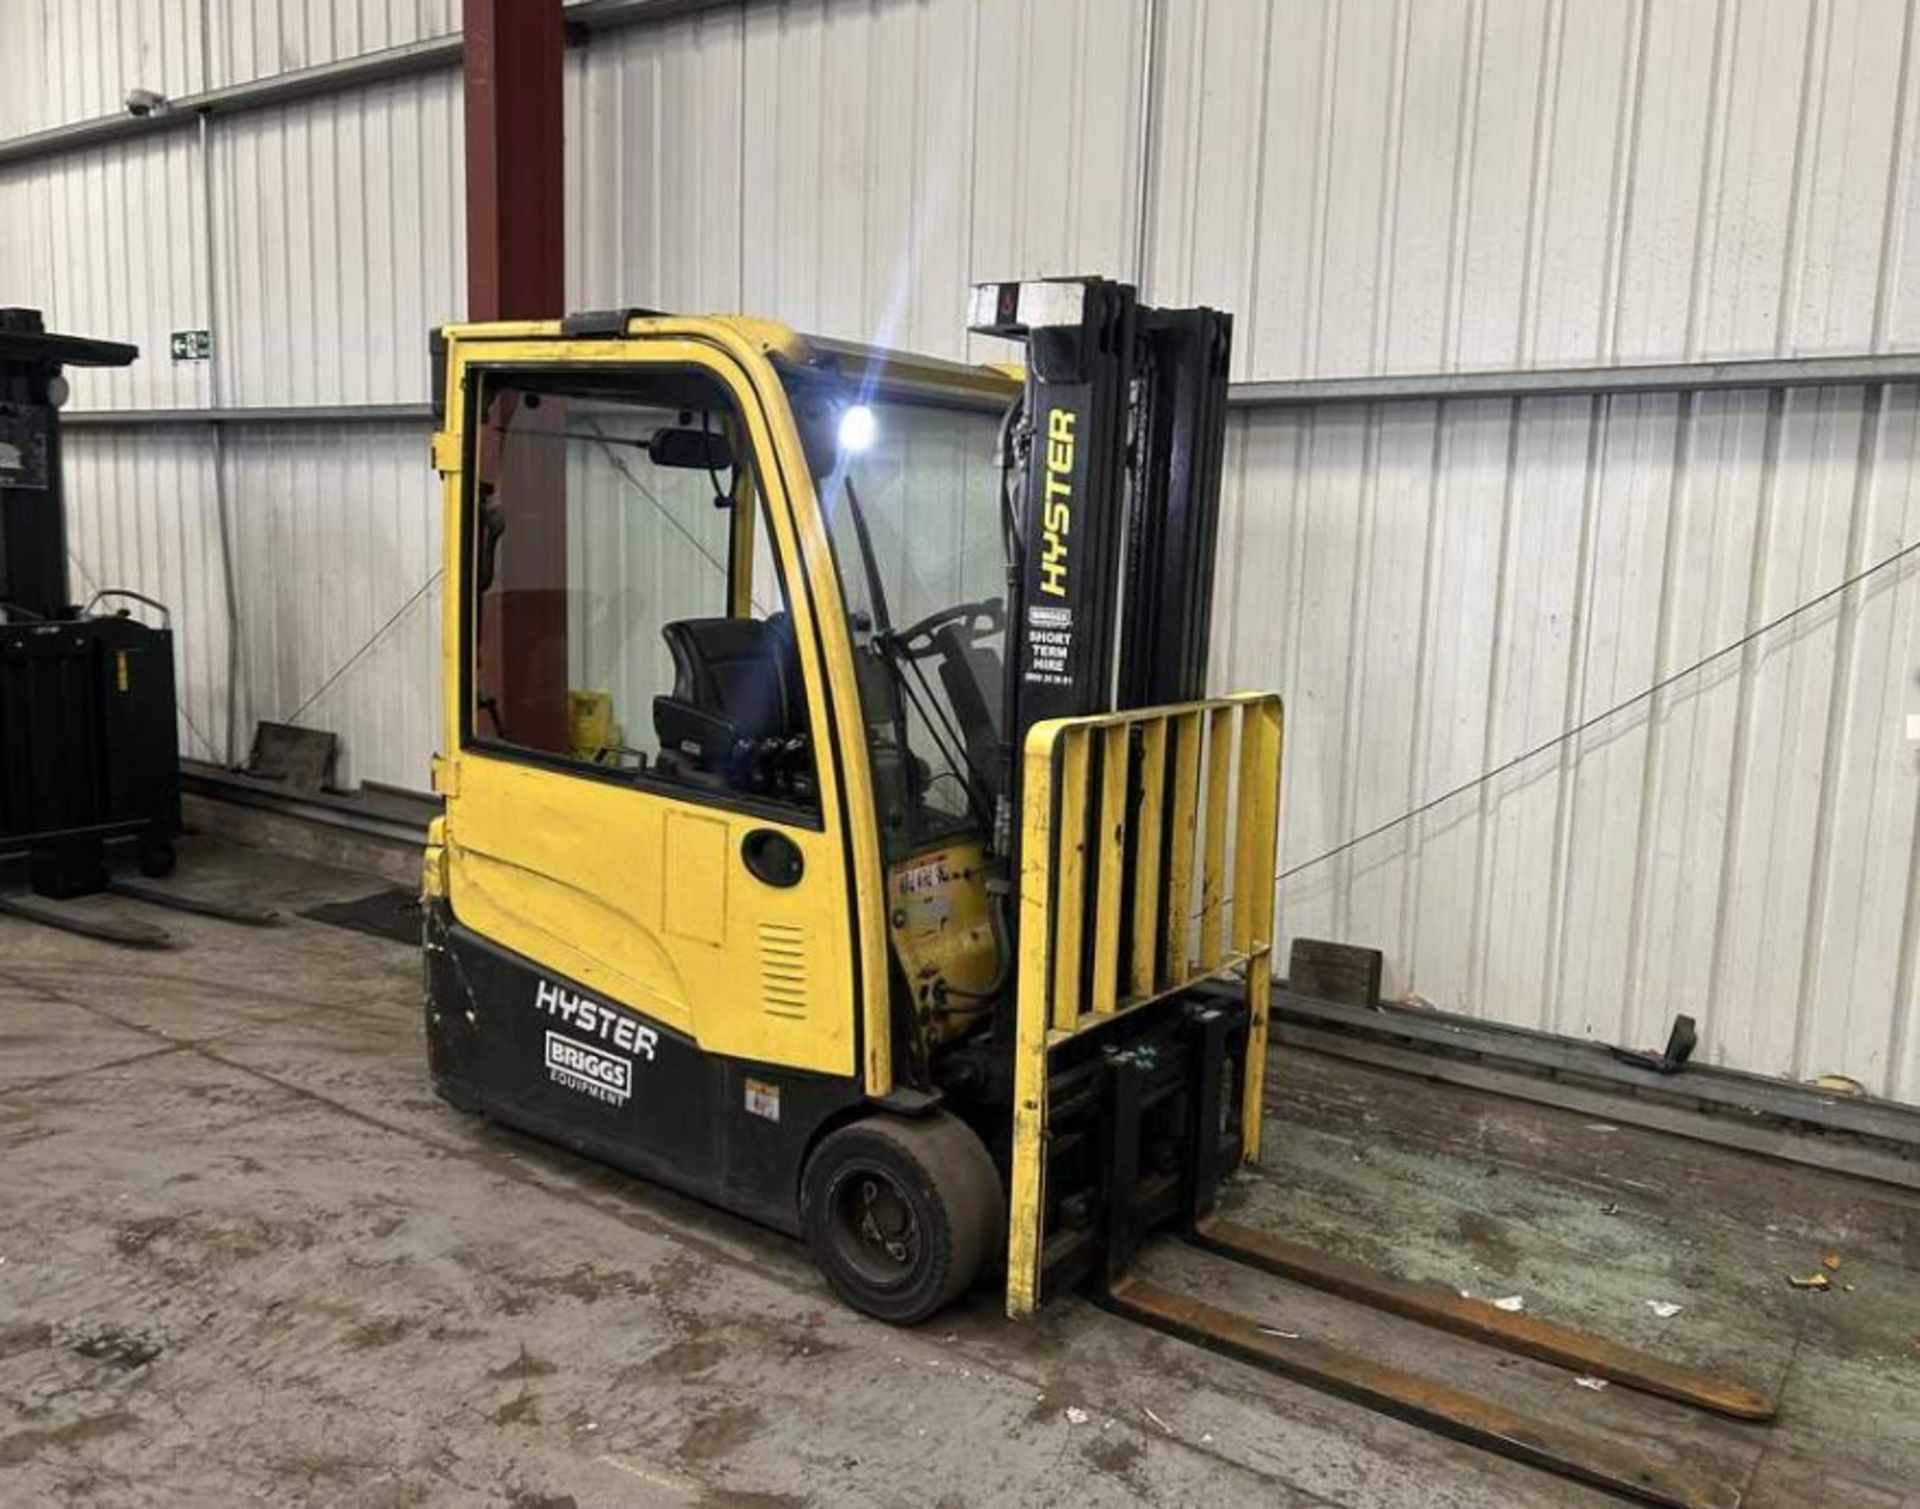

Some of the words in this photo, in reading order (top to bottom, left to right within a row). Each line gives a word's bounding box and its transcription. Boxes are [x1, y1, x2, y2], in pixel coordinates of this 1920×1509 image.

[1040, 408, 1077, 597] HYSTER
[1028, 630, 1072, 646] SHORT
[1032, 644, 1068, 659] TERM
[1033, 657, 1065, 672] HIRE
[535, 980, 659, 1061] HYSTER
[550, 1069, 625, 1108] EQUIPMENT
